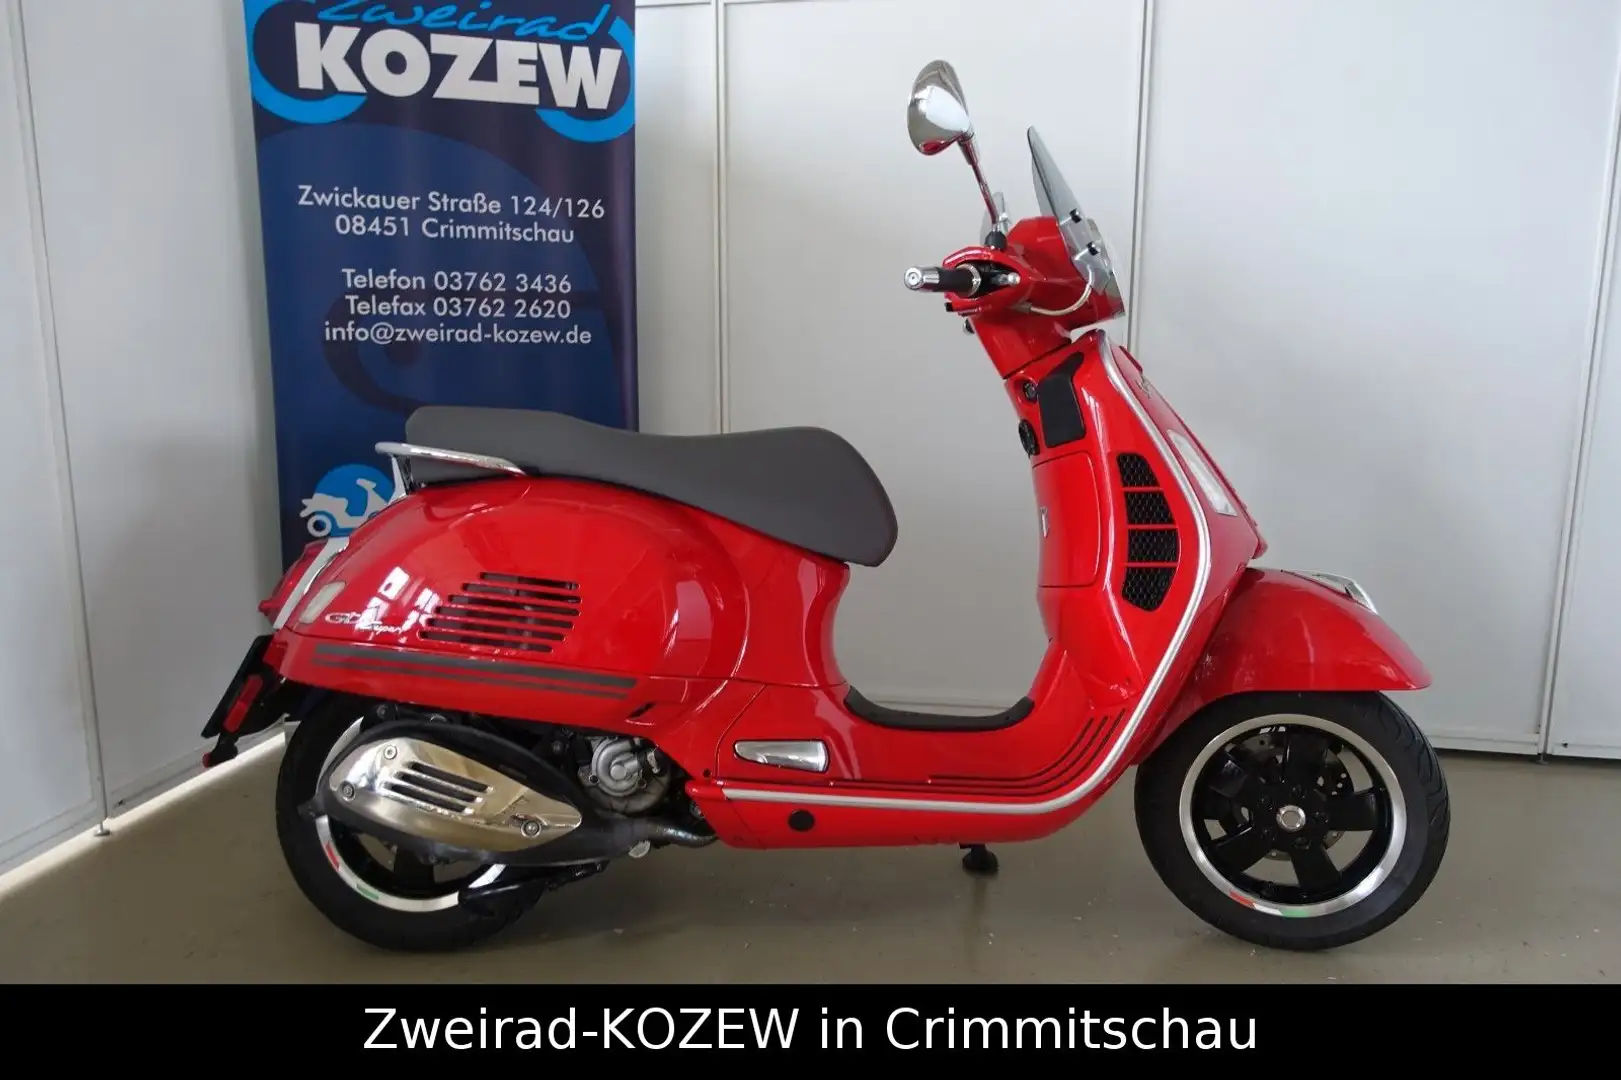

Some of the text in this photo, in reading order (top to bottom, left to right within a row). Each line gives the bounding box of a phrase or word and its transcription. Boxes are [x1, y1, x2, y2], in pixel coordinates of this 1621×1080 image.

[317, 0, 611, 41] Zweirad
[294, 22, 623, 110] KOZEW
[297, 185, 605, 219] Zwickauer Straße 124/126
[335, 214, 574, 243] 08451 Crimmitschau
[341, 268, 572, 294] Telefon 03762 3436
[345, 295, 571, 319] Telefax 03762 2620
[324, 321, 592, 345] info@zweirad-kozew.de
